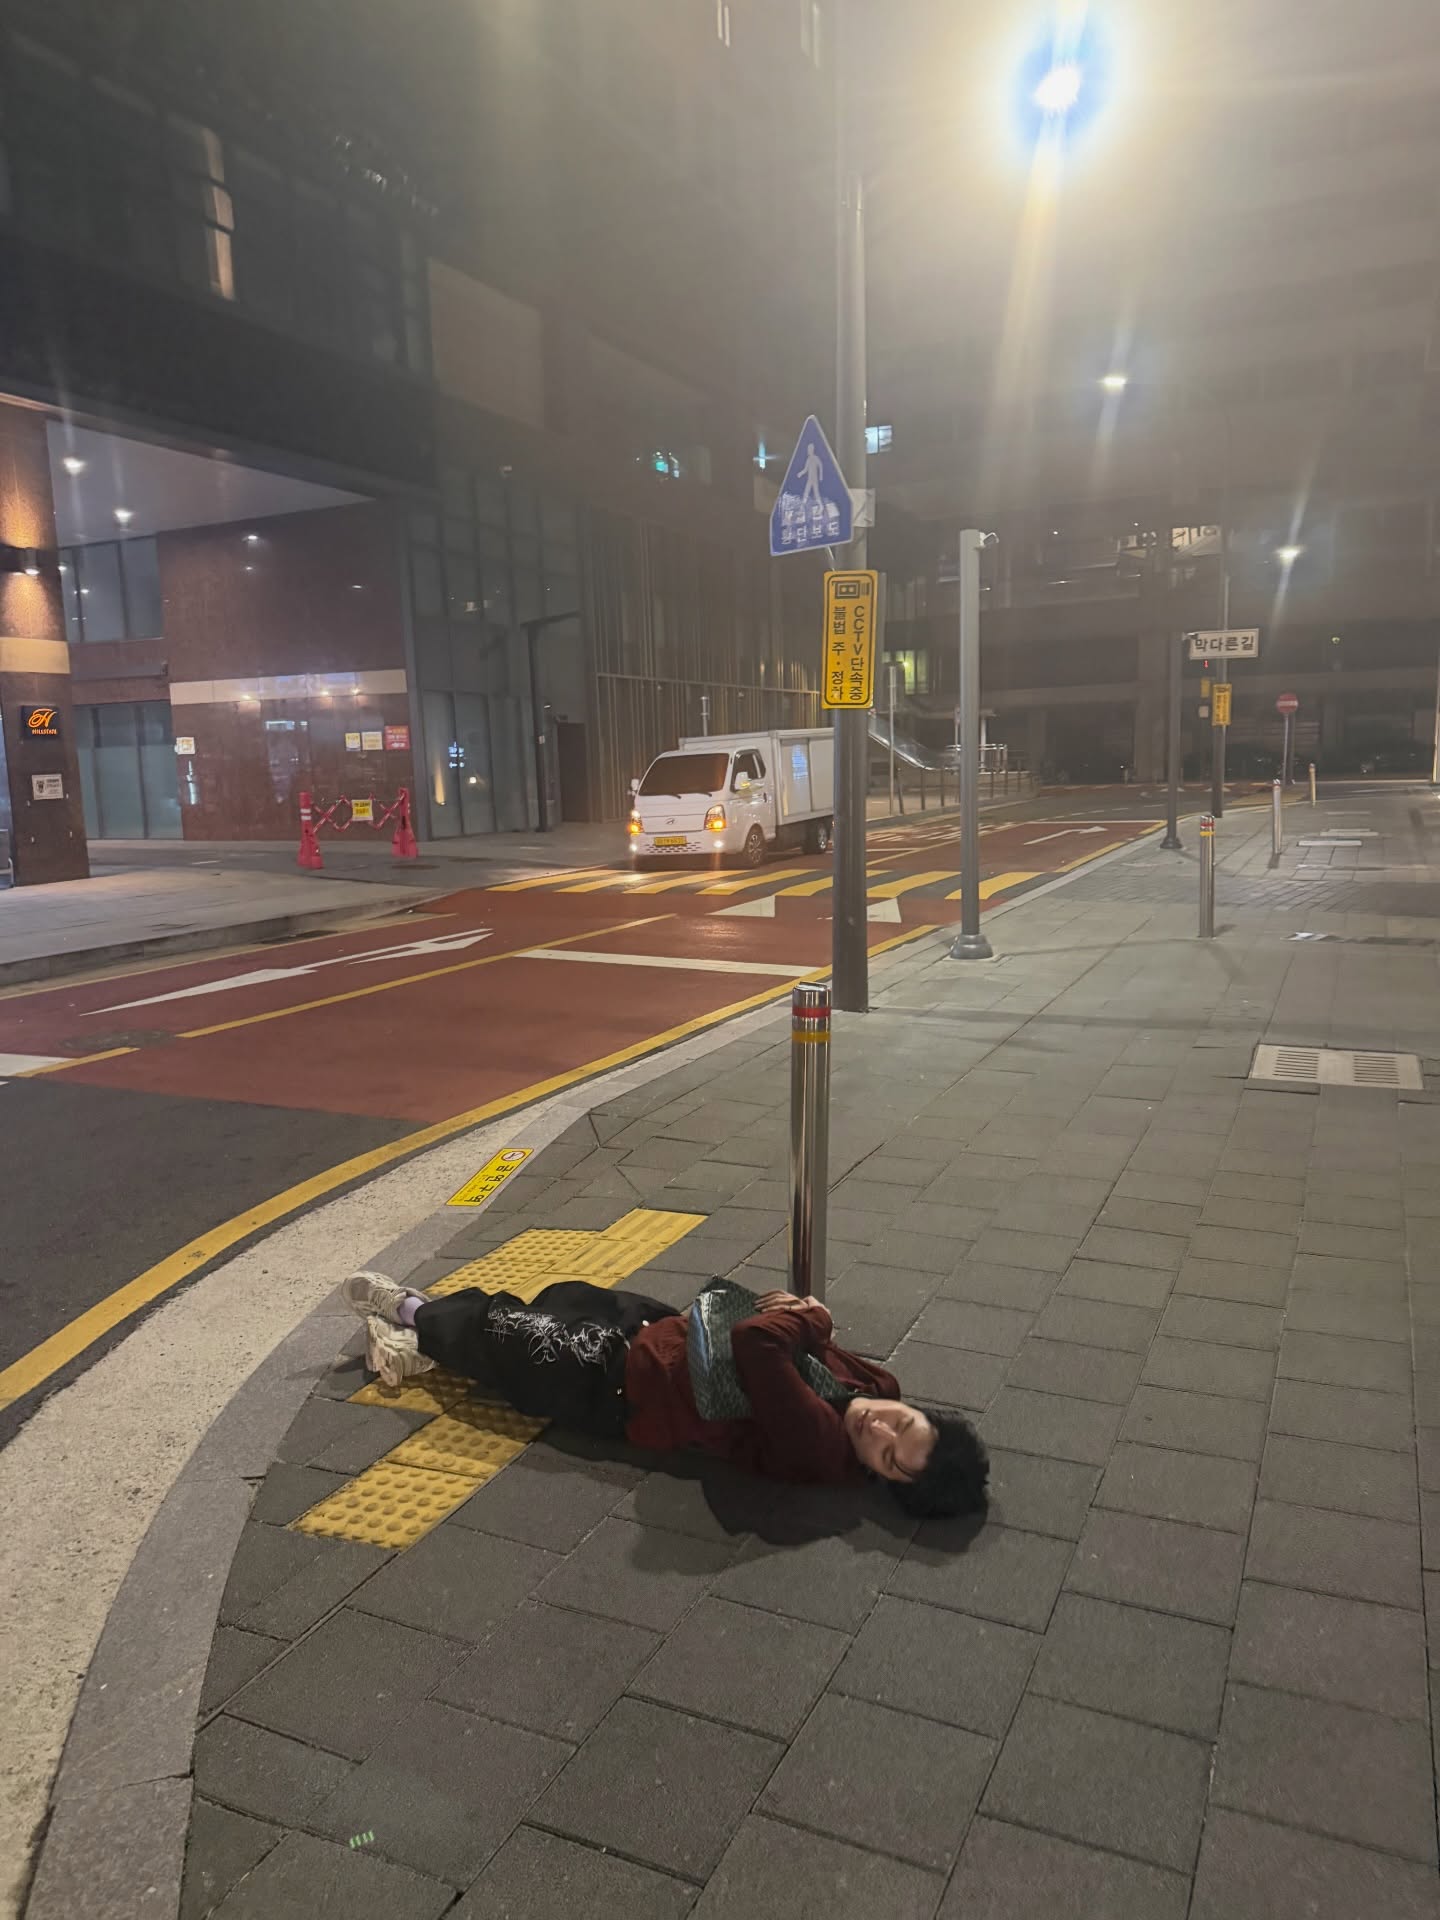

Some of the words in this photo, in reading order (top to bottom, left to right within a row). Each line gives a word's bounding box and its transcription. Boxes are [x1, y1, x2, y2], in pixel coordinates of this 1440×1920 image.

[832, 606, 847, 635] 불법
[849, 605, 865, 701] CCTV단속중
[1195, 635, 1254, 652] 막다른길
[464, 1165, 515, 1203] 금연구역
